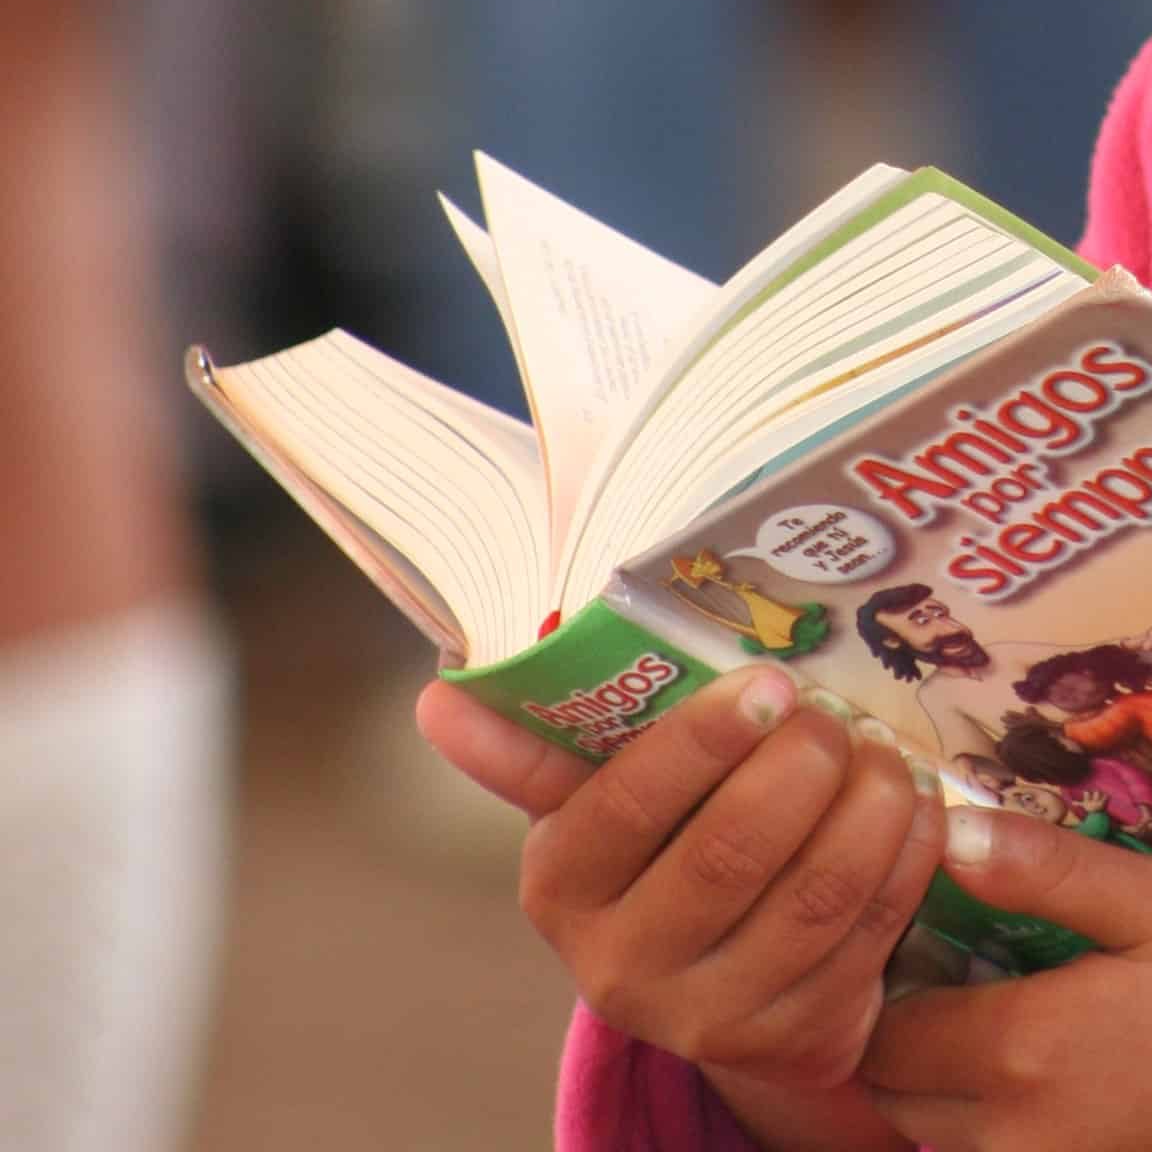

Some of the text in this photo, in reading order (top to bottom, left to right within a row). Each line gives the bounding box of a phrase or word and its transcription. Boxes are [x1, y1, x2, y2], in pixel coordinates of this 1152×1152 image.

[853, 344, 1148, 520] Amigos
[960, 461, 1044, 524] por
[524, 654, 672, 724] Amigos
